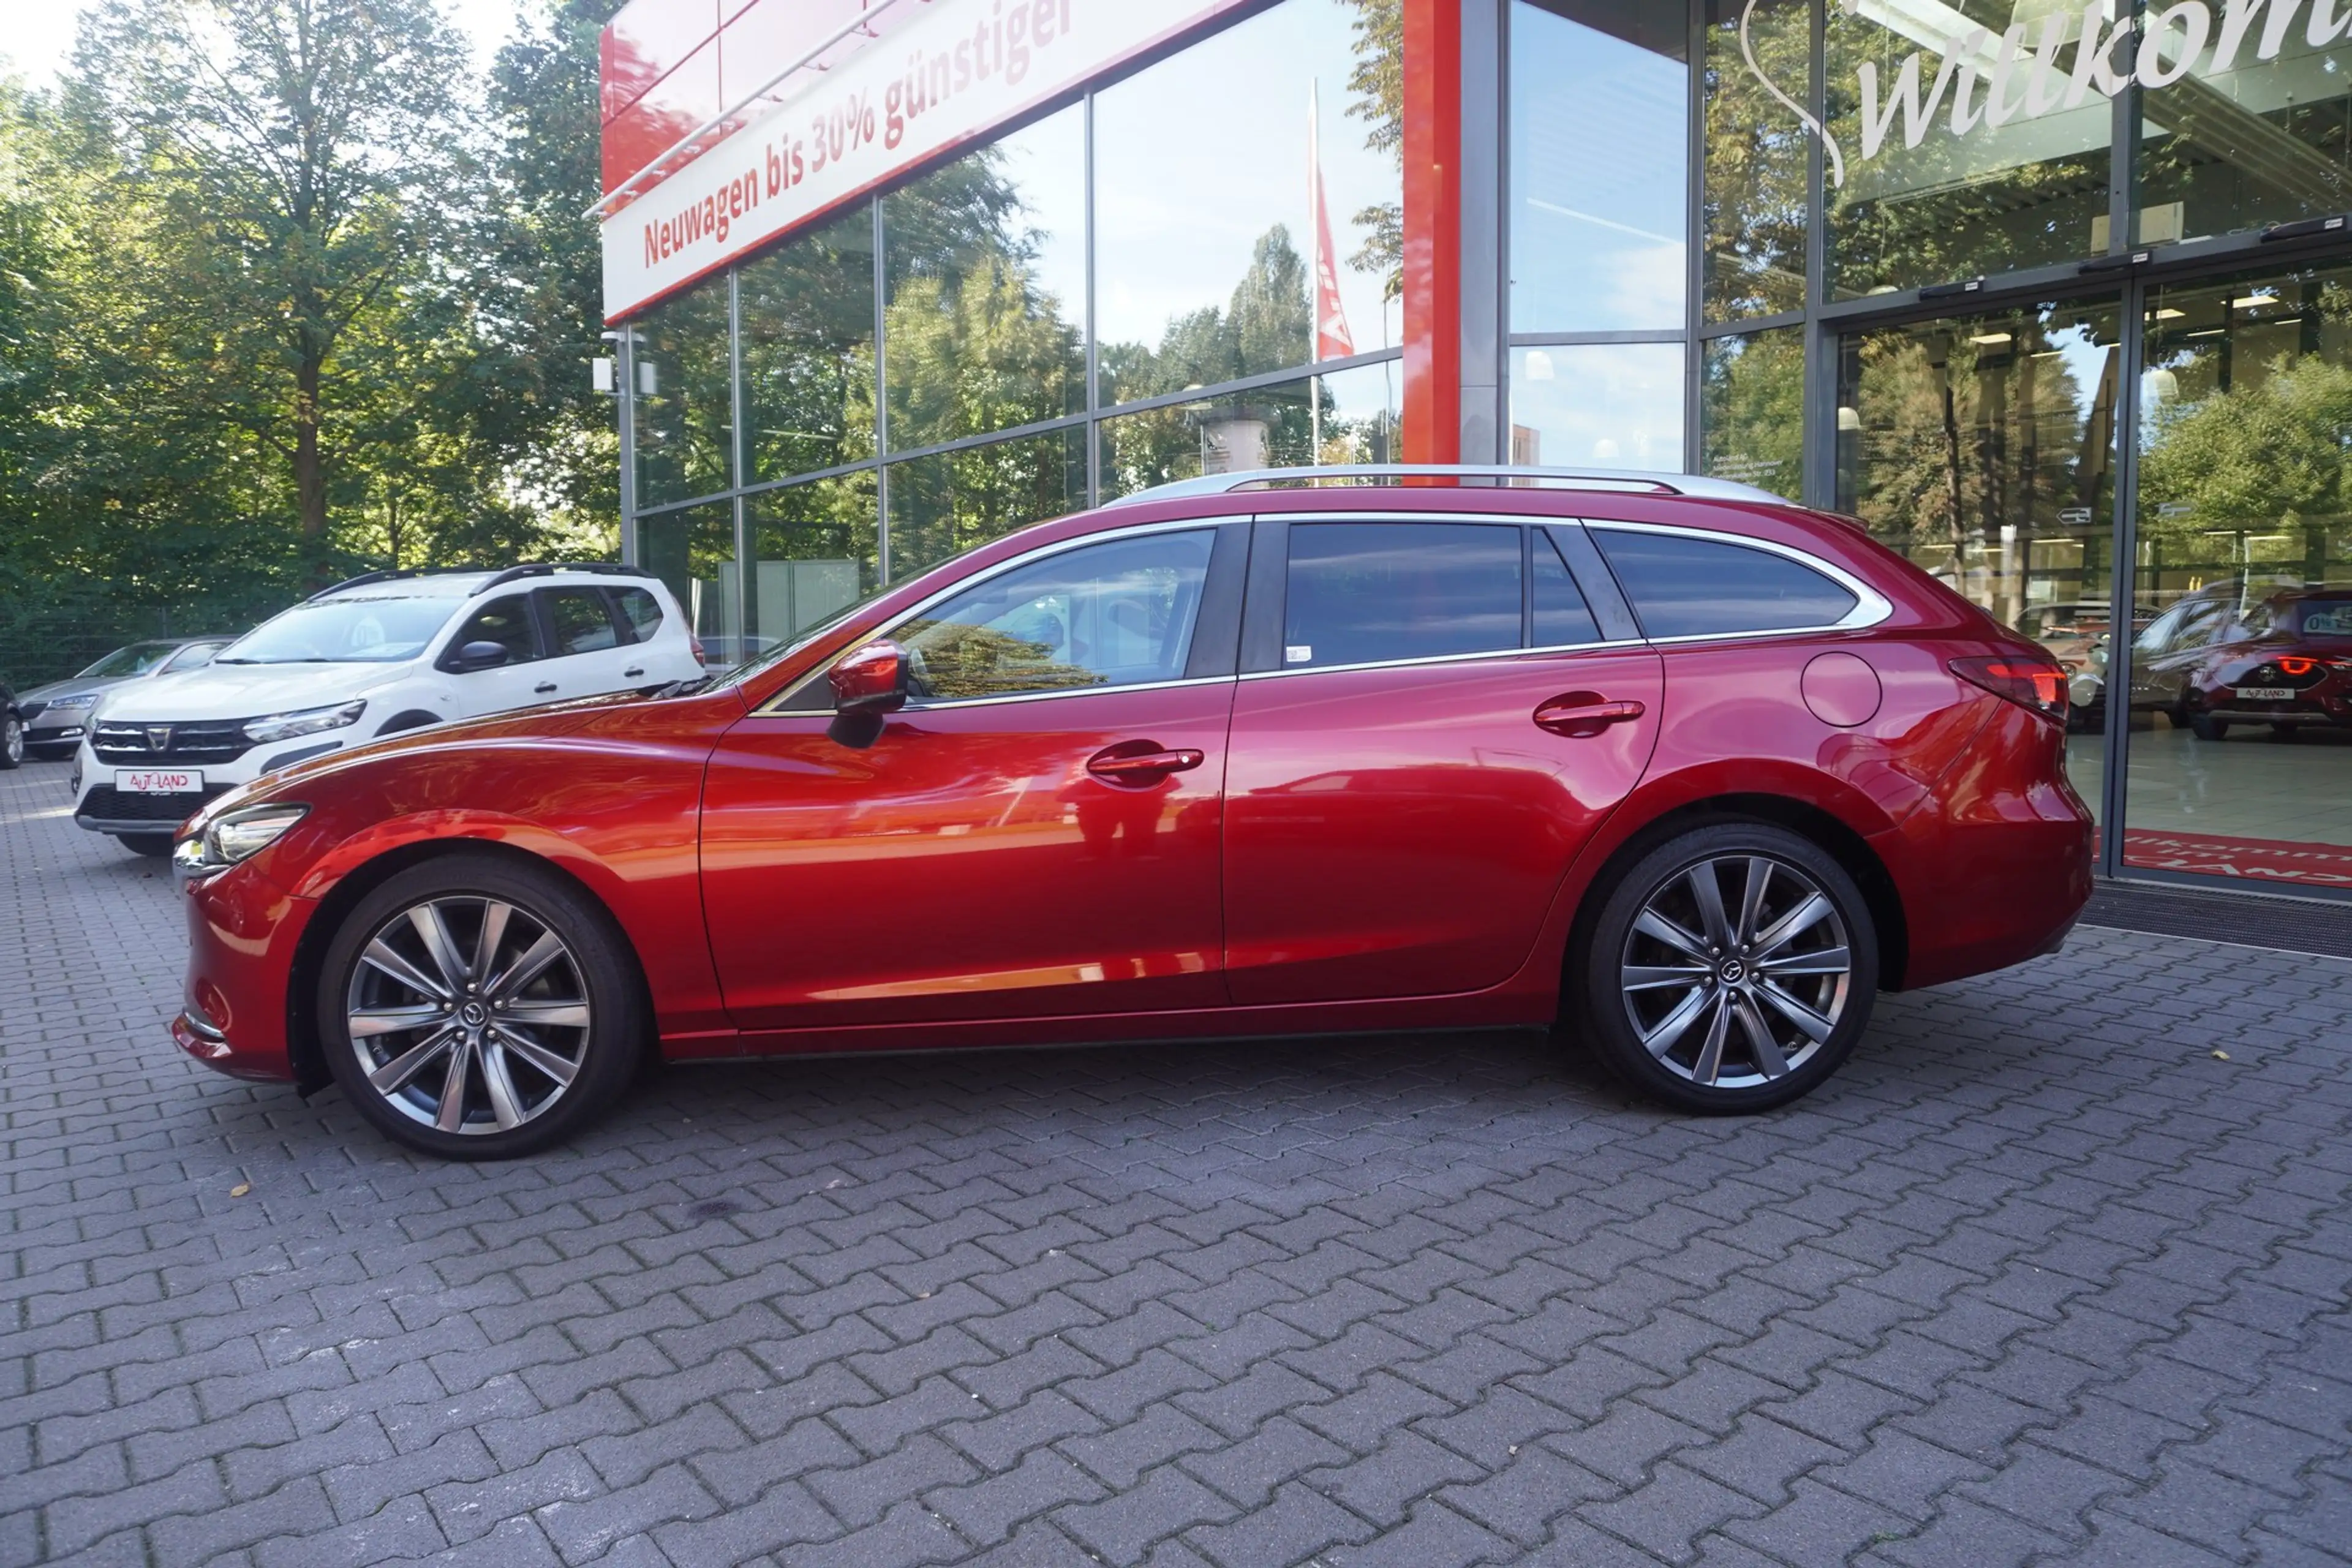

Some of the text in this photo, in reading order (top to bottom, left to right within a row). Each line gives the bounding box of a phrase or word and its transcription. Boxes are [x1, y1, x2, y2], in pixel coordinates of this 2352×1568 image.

[1856, 0, 2352, 160] Willkom
[644, 169, 758, 268] Neuwagen
[766, 132, 804, 200] bis
[812, 85, 875, 173] 30%
